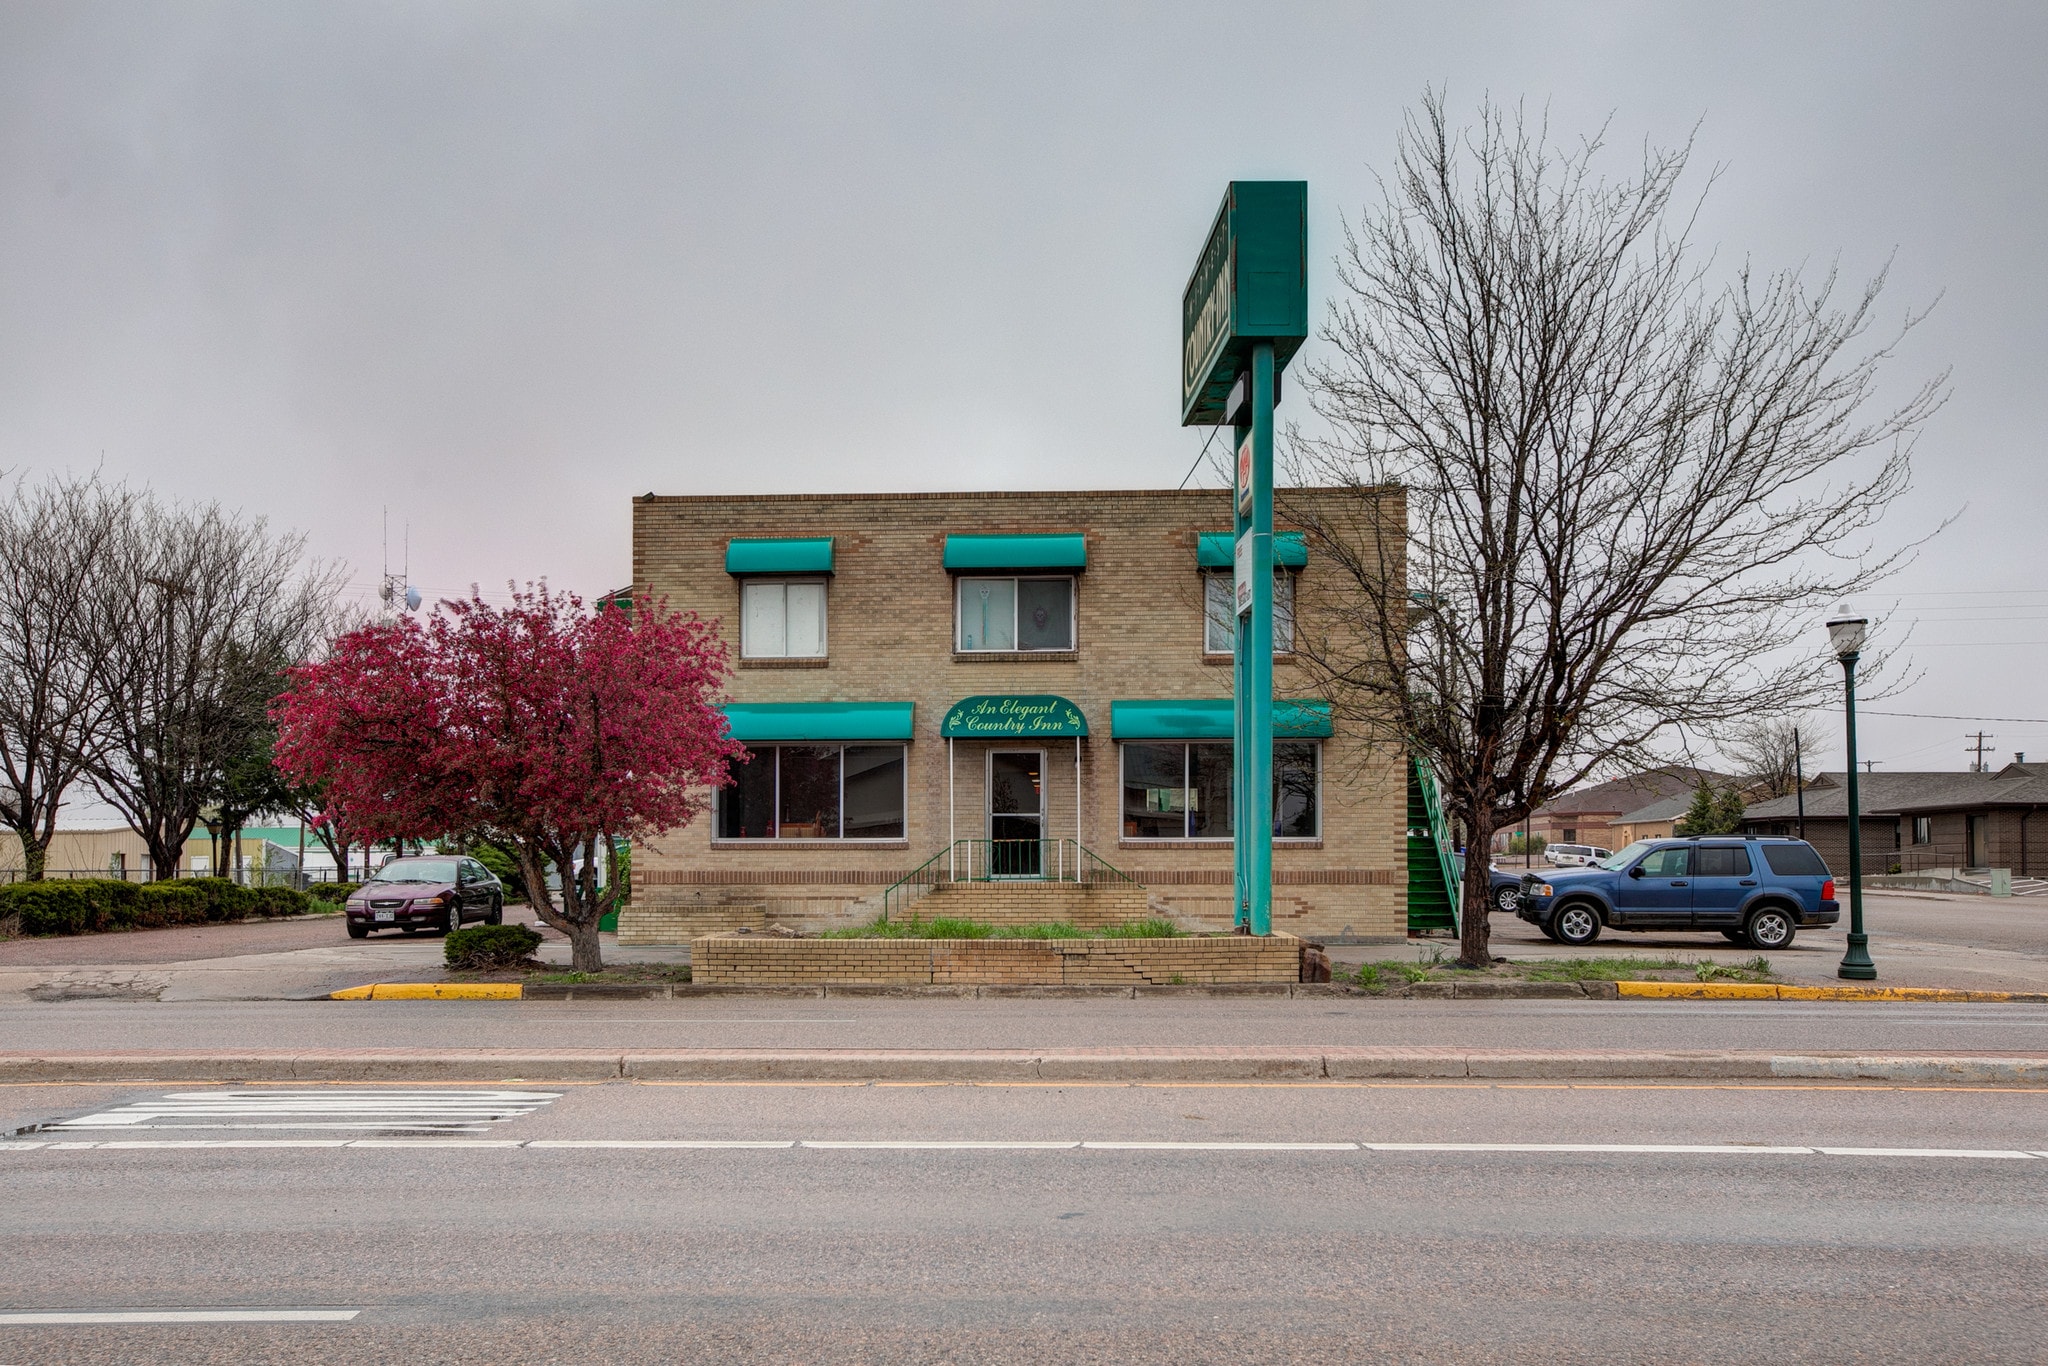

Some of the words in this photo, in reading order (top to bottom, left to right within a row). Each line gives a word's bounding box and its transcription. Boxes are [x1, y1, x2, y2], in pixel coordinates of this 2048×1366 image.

[971, 699, 997, 715] An
[999, 699, 1058, 720] Elegant
[965, 715, 1026, 734] Country
[1028, 715, 1064, 731] Inn
